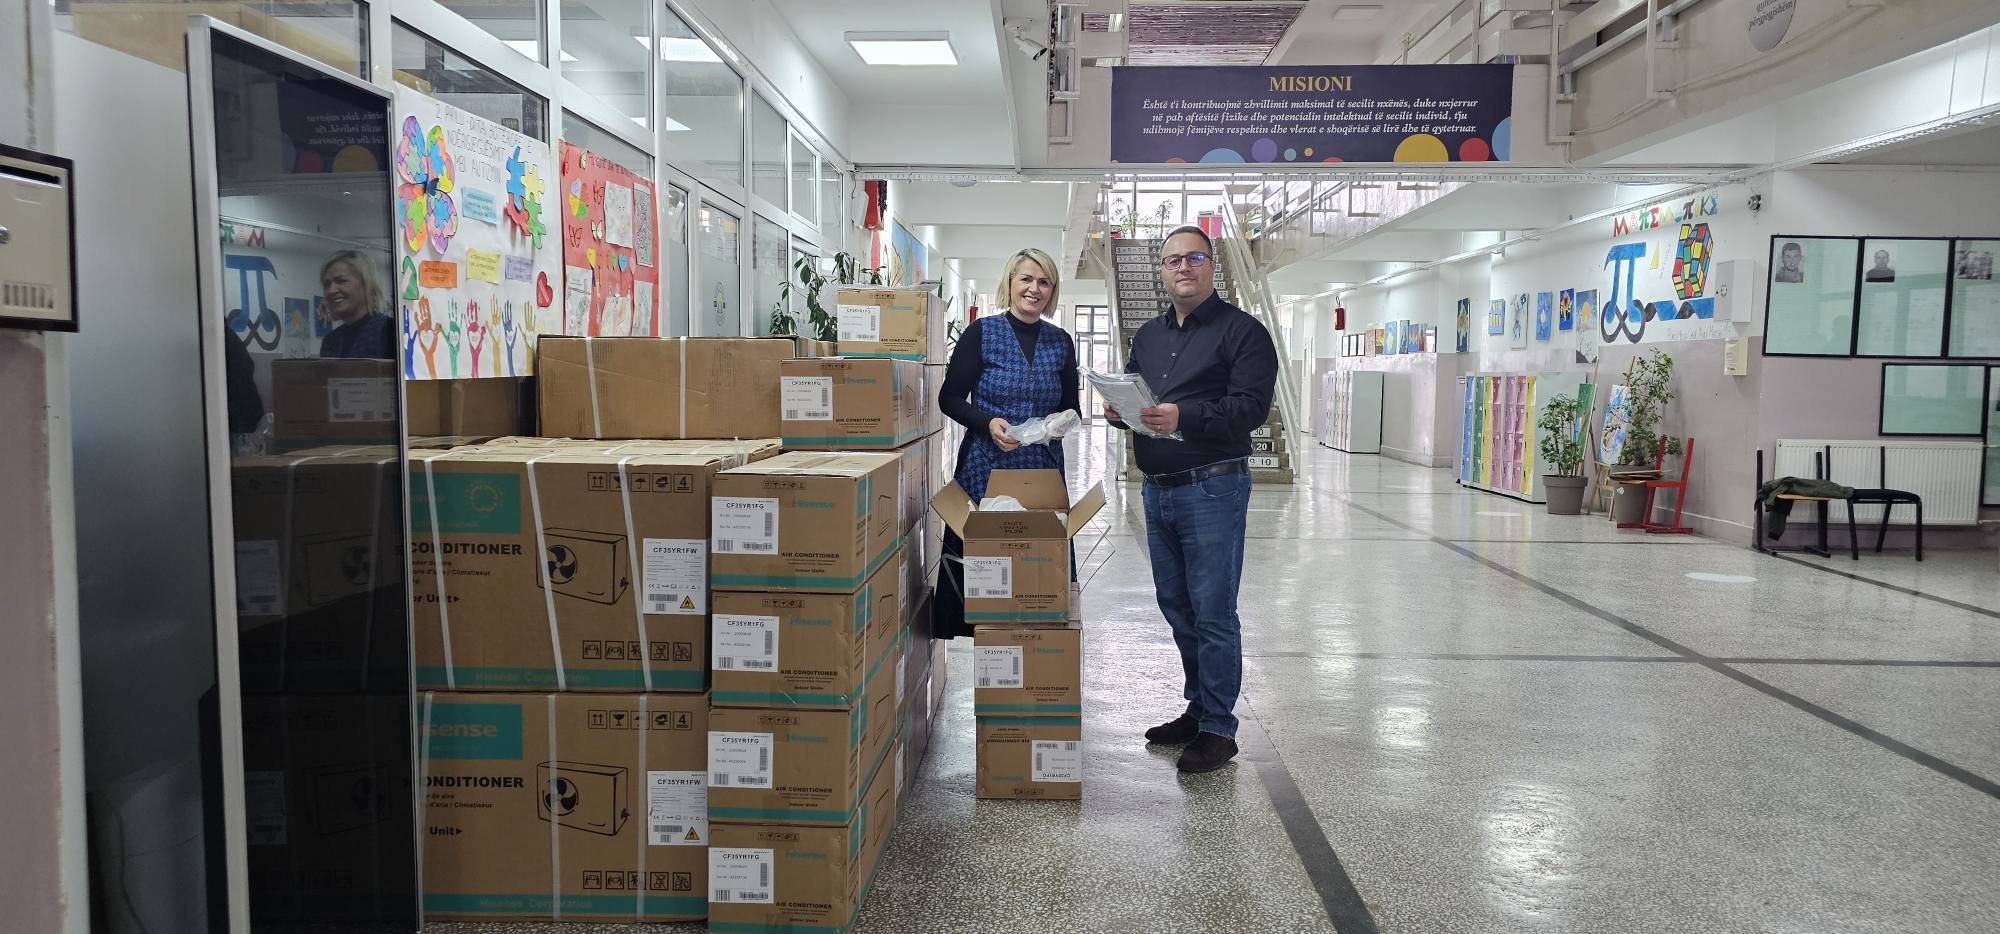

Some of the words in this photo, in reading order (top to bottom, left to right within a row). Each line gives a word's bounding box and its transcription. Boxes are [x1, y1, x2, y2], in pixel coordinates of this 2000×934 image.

[1268, 75, 1352, 92] MISIONI
[1143, 99, 1168, 109] Është
[1180, 99, 1242, 111] kontribuojmë
[1244, 98, 1289, 109] zhvillimit
[1291, 98, 1334, 109] maksimal
[1336, 99, 1345, 108] të
[1347, 98, 1375, 108] secilit
[1377, 100, 1411, 110] nxënës,
[1413, 98, 1437, 108] duke
[1438, 99, 1479, 110] nxjerrur
[1152, 113, 1163, 122] në
[1166, 113, 1183, 124] pah
[1185, 112, 1219, 123] aftësitë
[1220, 112, 1248, 123] fizike
[1250, 112, 1268, 121] dhe
[1269, 112, 1321, 124] potencialin
[1323, 111, 1372, 121] intelektual
[1374, 111, 1384, 121] të
[1385, 111, 1413, 121] secilit
[1415, 110, 1450, 121] individ,
[1142, 125, 1185, 136] ndihmojë
[1186, 125, 1225, 136] fëmijëve
[1226, 124, 1269, 136] respektin
[1270, 124, 1287, 133] dhe
[1289, 124, 1317, 133] vlerat
[1326, 123, 1370, 136] shoqërisë
[1371, 124, 1381, 133] së
[1383, 123, 1400, 133] lirë
[1401, 123, 1419, 133] dhe
[1421, 123, 1430, 132] të
[1432, 123, 1477, 136] qytetruar.
[1256, 442, 1268, 451] 20
[726, 502, 765, 510] CF35YR1FG
[411, 542, 523, 555] CODITIONER
[727, 620, 765, 628] CF35YR1FG
[424, 723, 498, 737] sense
[429, 826, 454, 836] Unit
